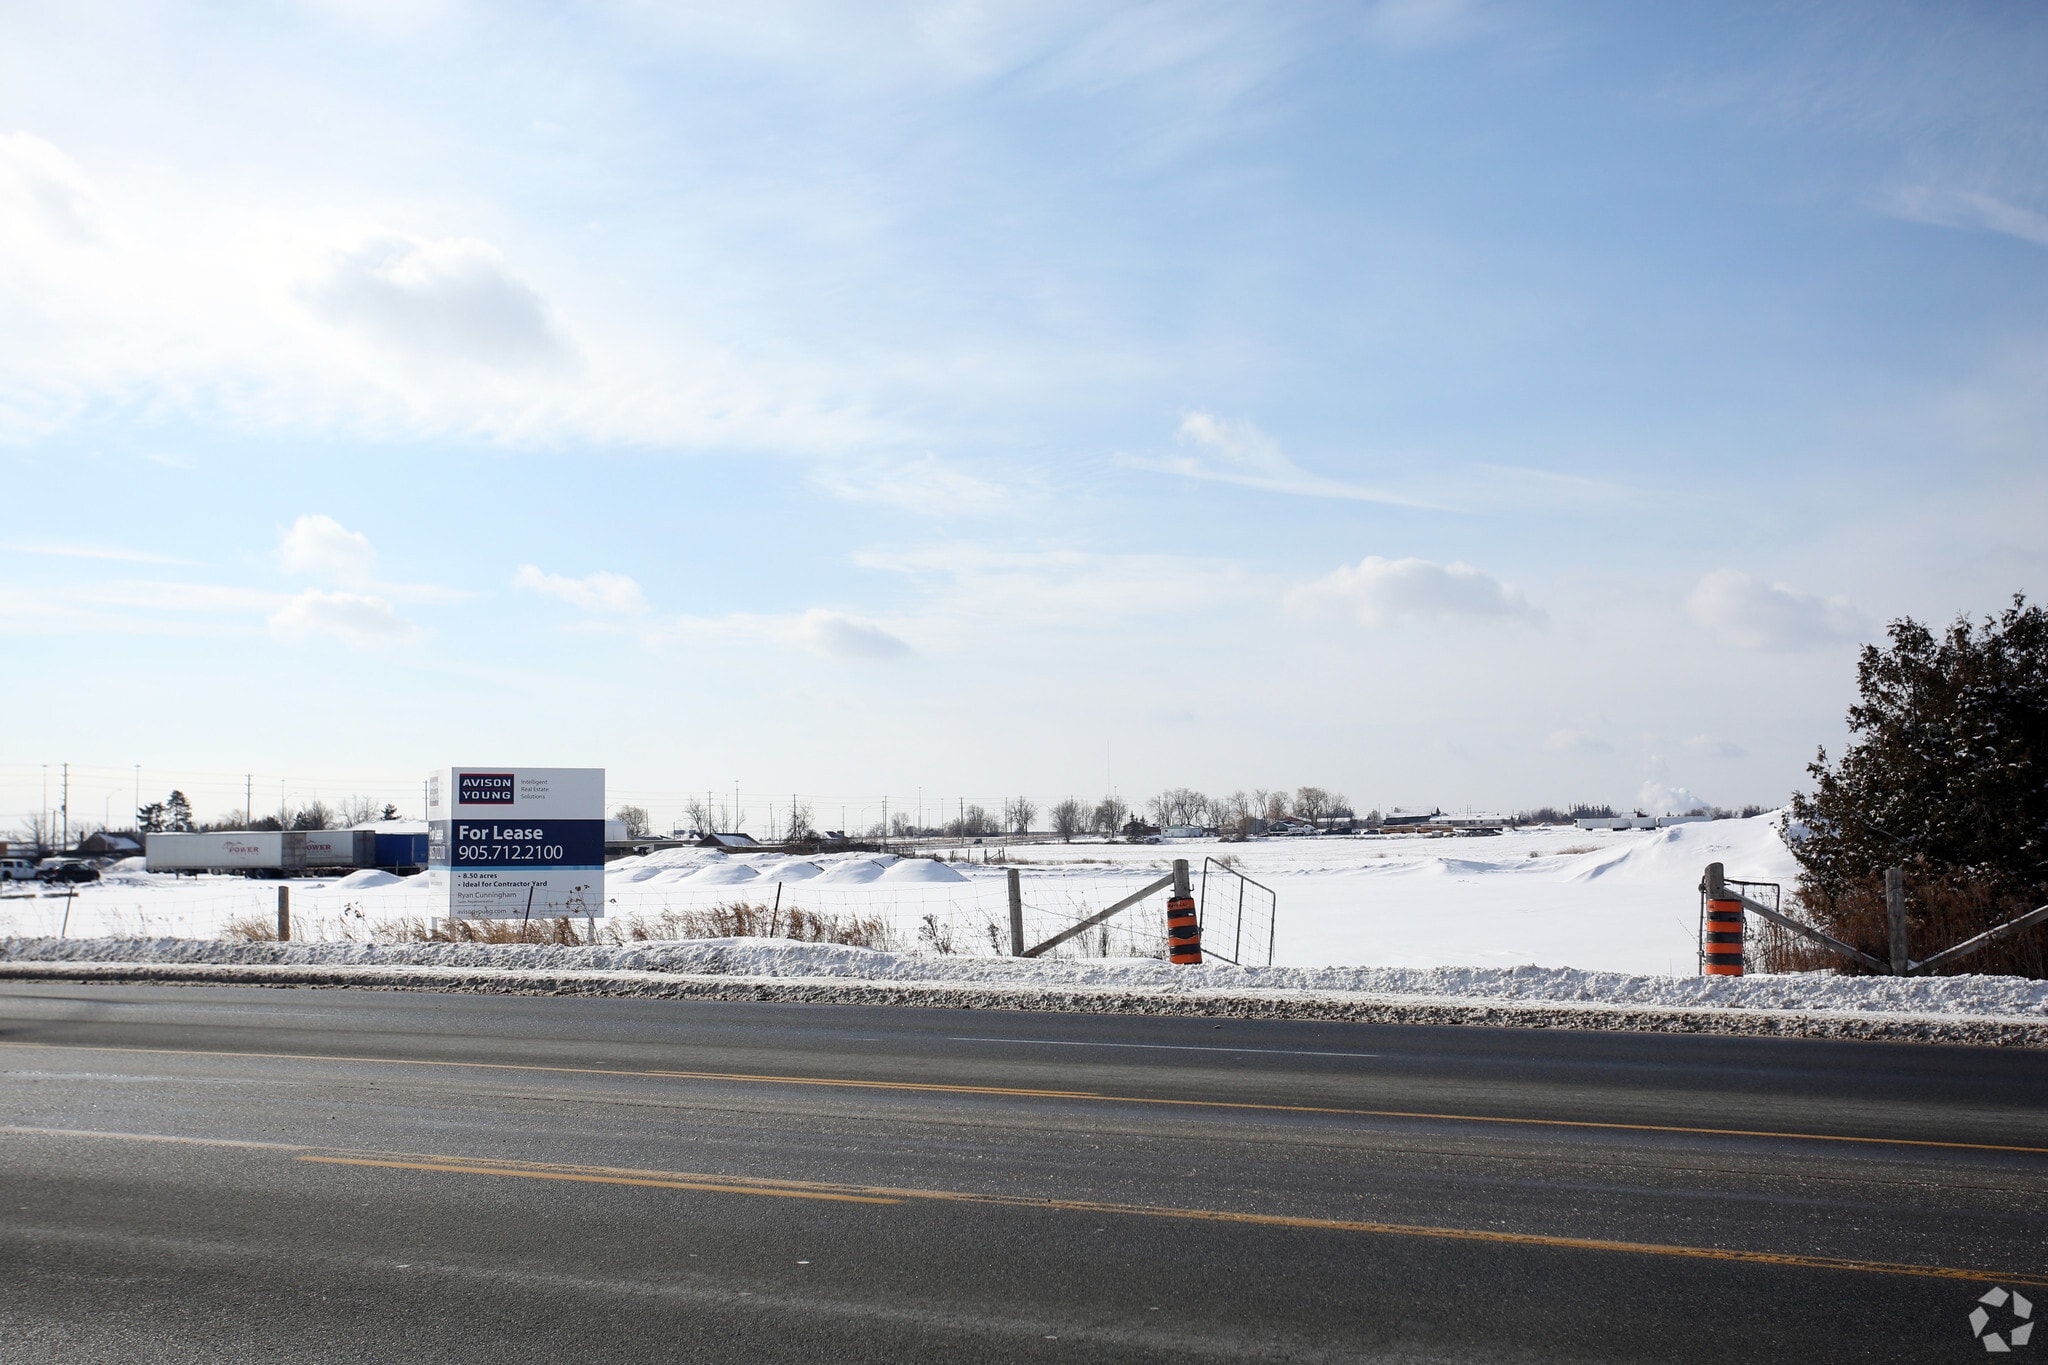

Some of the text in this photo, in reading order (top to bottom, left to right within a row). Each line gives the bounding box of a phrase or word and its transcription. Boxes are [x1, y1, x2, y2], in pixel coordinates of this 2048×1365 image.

[462, 778, 511, 787] AVISON
[462, 791, 511, 800] YOUNG
[459, 825, 544, 840] For Lease
[458, 845, 563, 860] 905.712.2100
[457, 890, 517, 899] Ryan Cunningham
